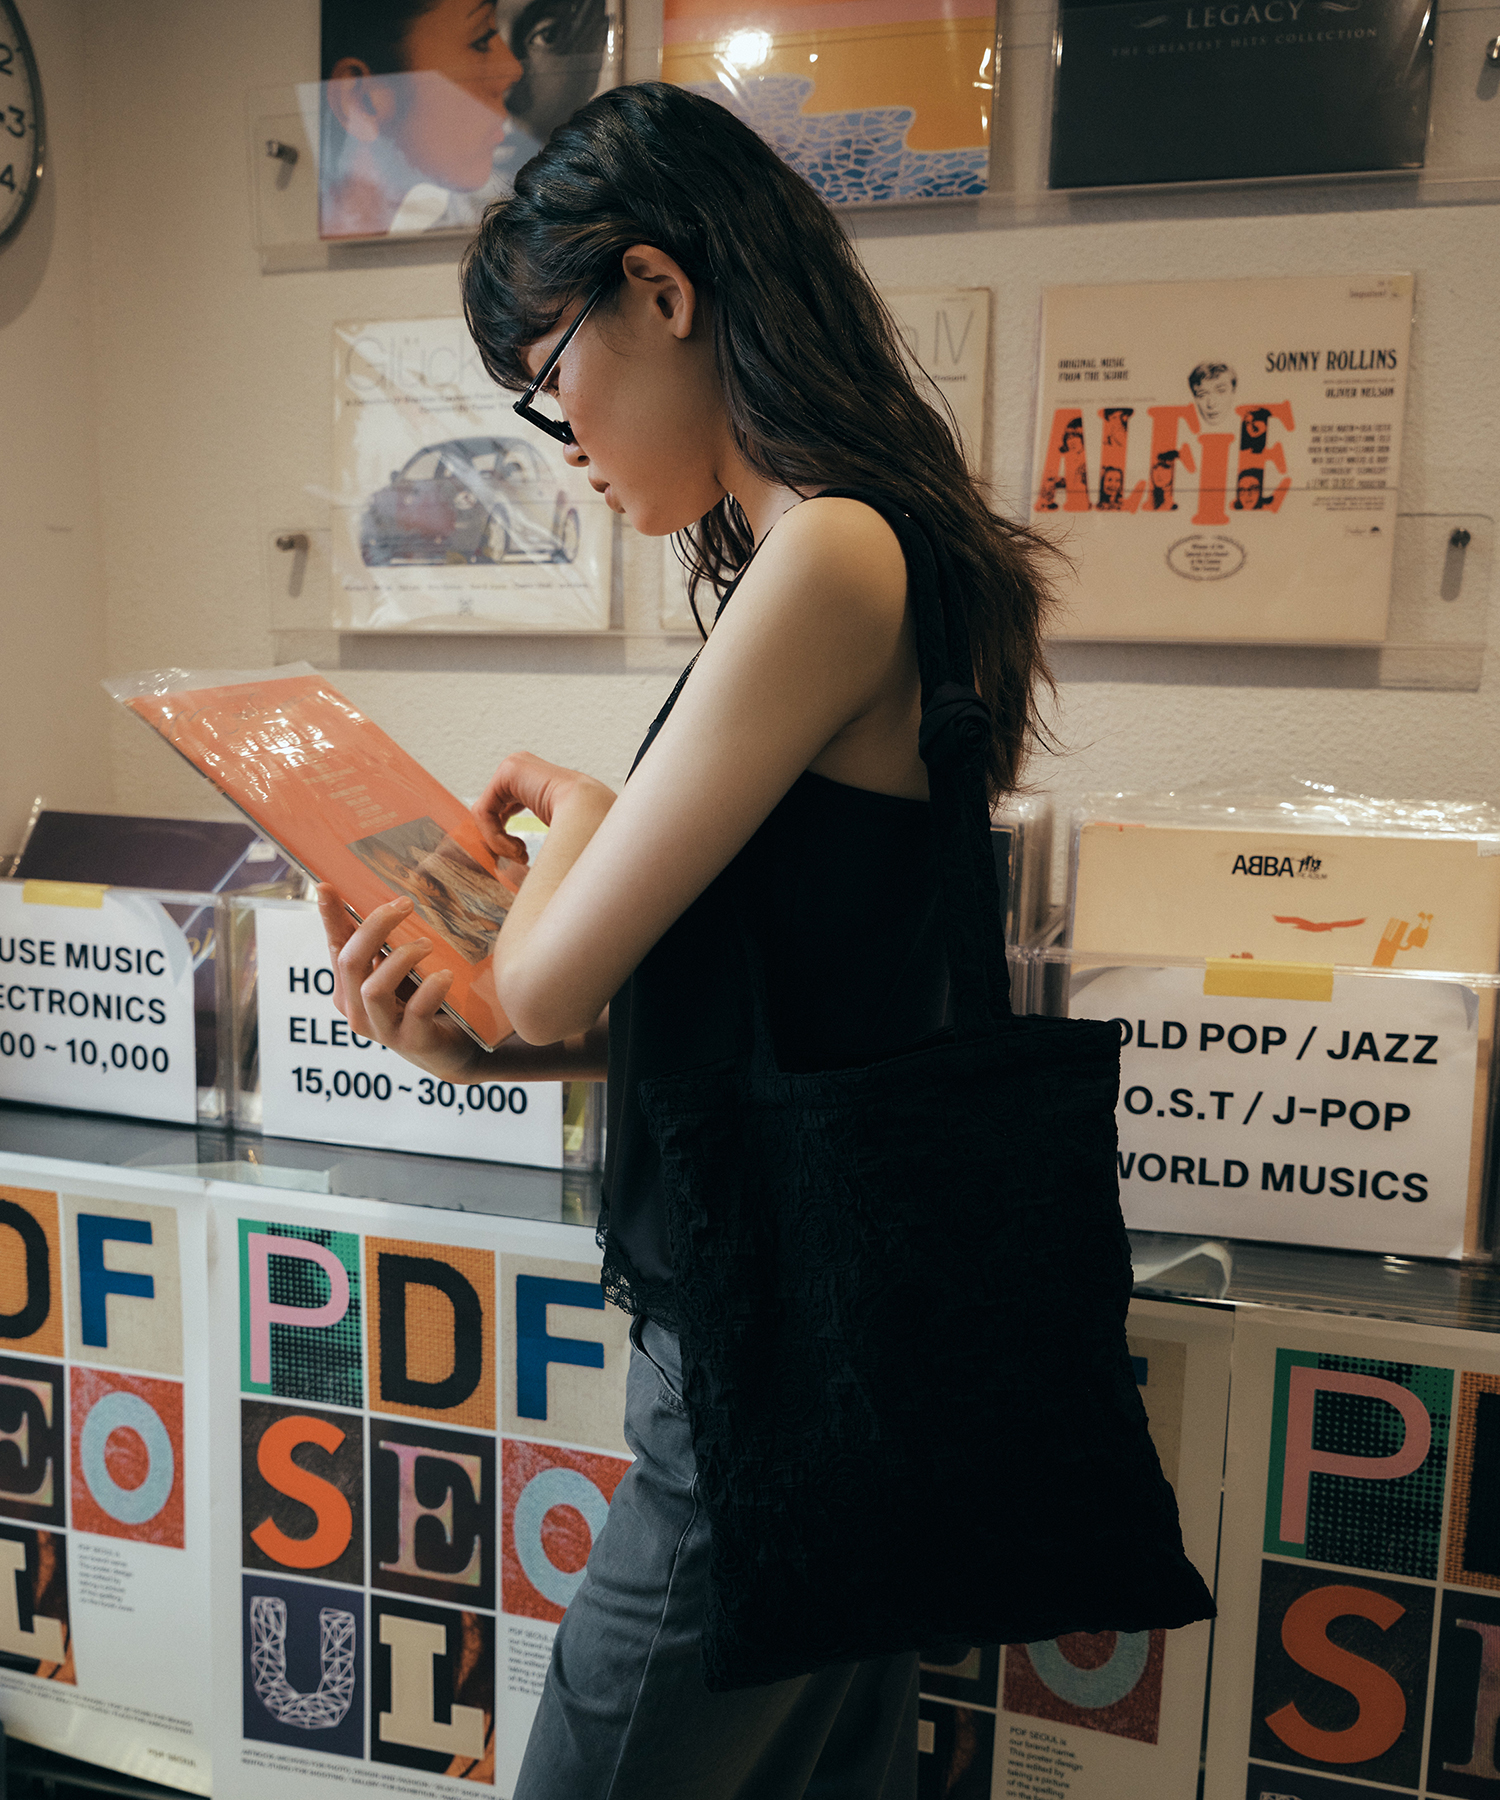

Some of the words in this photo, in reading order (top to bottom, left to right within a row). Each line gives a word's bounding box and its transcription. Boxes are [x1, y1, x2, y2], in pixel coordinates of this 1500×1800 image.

[1186, 1, 1302, 29] LEGACY
[1230, 36, 1266, 48] HITS
[1275, 28, 1378, 44] COLLECTION
[7, 105, 25, 137] 3
[1265, 351, 1320, 373] SONNY
[1326, 349, 1397, 371] ROLLINS
[1034, 400, 1296, 525] ALFIE
[1231, 855, 1294, 877] ABBA
[66, 943, 165, 976] MUSIC
[0, 984, 166, 1025] CTRONICS
[1200, 1022, 1287, 1054] POP
[1327, 1030, 1438, 1064] JAZZ
[1123, 1086, 1234, 1121] O.S.T
[1272, 1096, 1411, 1132] J-POP
[1261, 1162, 1428, 1203] MUSICS
